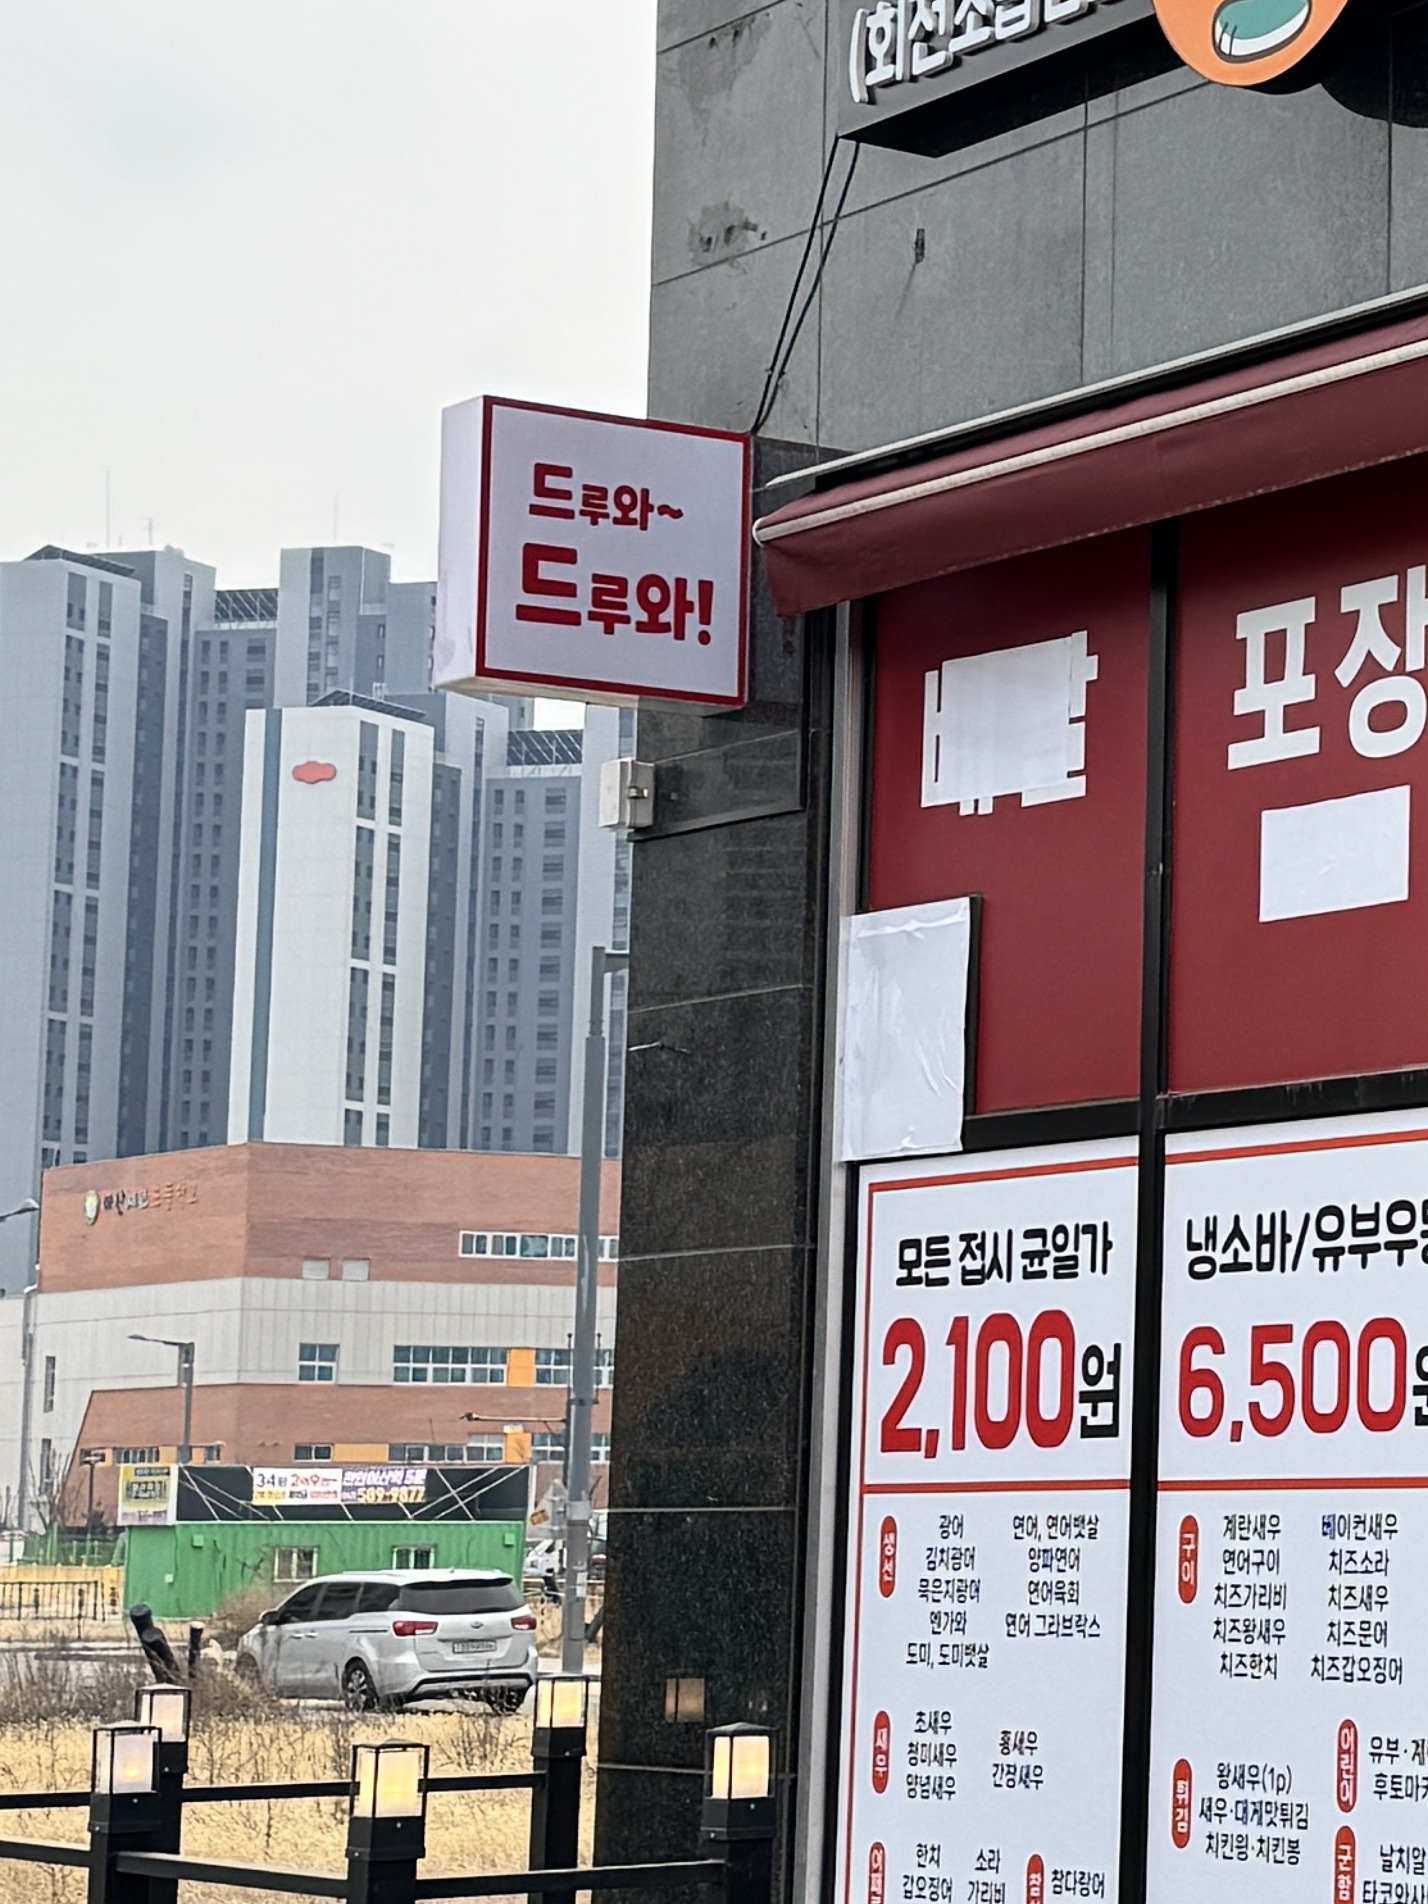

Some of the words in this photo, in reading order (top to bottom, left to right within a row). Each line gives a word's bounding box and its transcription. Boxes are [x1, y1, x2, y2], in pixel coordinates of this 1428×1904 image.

[528, 462, 684, 530] 드루와~
[515, 542, 714, 646] 드루와!
[896, 1235, 951, 1287] 모든
[959, 1229, 1013, 1286] 접시
[1021, 1221, 1113, 1280] 균일가
[881, 1310, 1121, 1459] 2,100원
[939, 1515, 963, 1539] 광어
[1013, 1515, 1041, 1541] 연어,
[1047, 1515, 1099, 1539] 연어뱃살
[1223, 1514, 1281, 1541] 계란새우
[1322, 1514, 1398, 1541] 베이컨새우
[926, 1546, 975, 1571] 김치광어
[1029, 1548, 1080, 1573] 양파연어
[1182, 1534, 1195, 1584] 구이
[1223, 1549, 1279, 1575] 연어구이
[1329, 1549, 1389, 1576] 치즈소라
[918, 1578, 980, 1603] 묵은지광어
[1028, 1580, 1079, 1605] 연어육회
[1214, 1583, 1286, 1610] 치즈가리비
[1328, 1584, 1388, 1612] 치즈새우
[1006, 1613, 1030, 1637] 연어
[1034, 1614, 1100, 1638] 그라브락스
[1213, 1617, 1286, 1645] 치즈왕새우
[1327, 1621, 1387, 1647] 치즈문어
[906, 1643, 934, 1669] 도미,
[938, 1643, 989, 1668] 도미뱃살
[1220, 1652, 1277, 1680] 치즈한치
[1311, 1655, 1402, 1685] 치즈갑오징어
[1217, 1763, 1292, 1795] 왕새우(1p)
[917, 1843, 940, 1868] 한치
[975, 1849, 1000, 1874] 소라
[1380, 1844, 1426, 1875] 날치알
[903, 1875, 952, 1903] 갑오징어
[1052, 1869, 1104, 1898] 참다랑어
